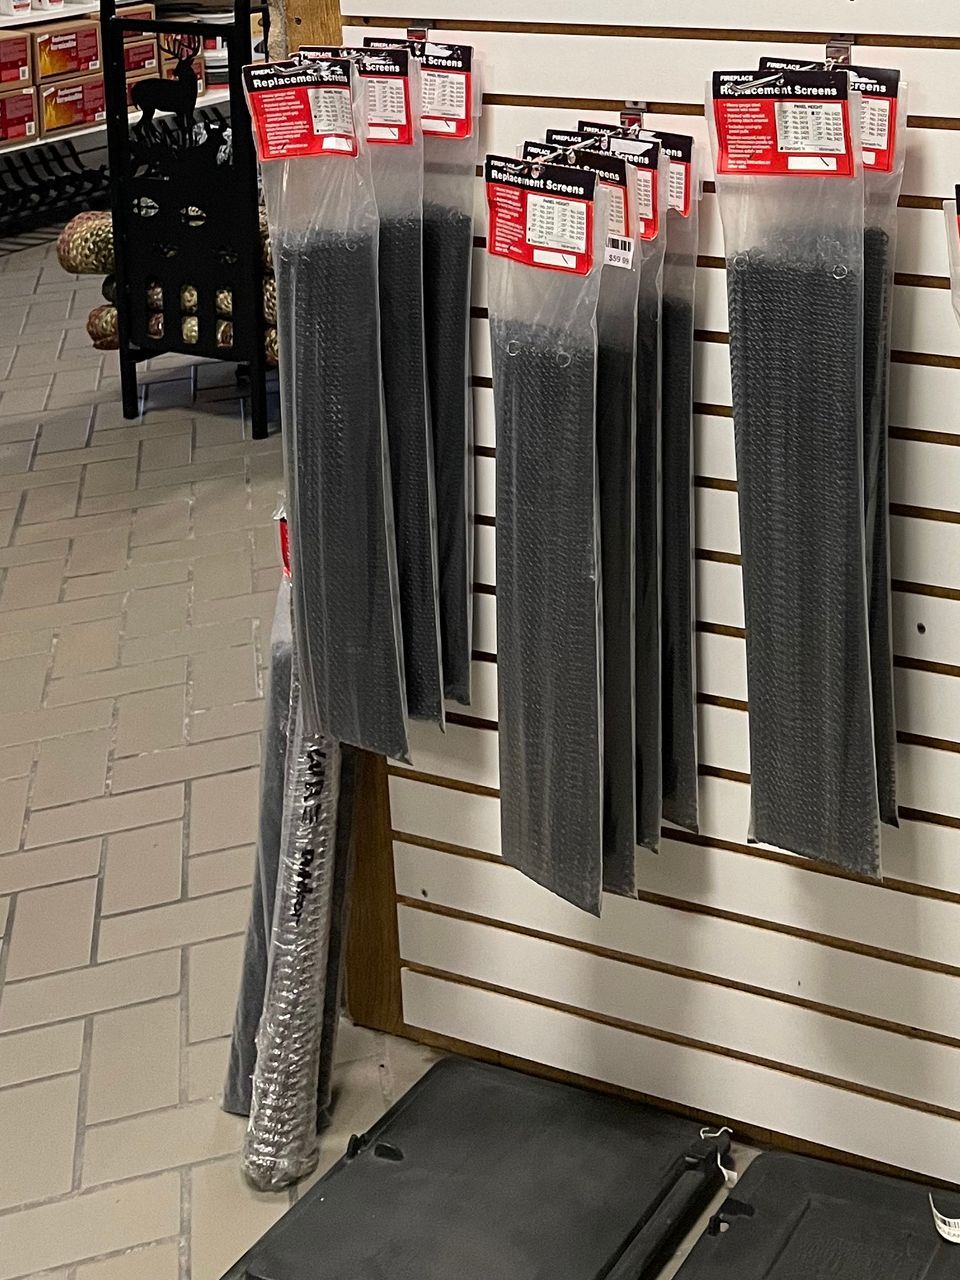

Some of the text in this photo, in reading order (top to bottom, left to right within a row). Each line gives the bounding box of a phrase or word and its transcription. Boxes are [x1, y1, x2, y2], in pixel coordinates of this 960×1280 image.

[365, 63, 400, 73] Screens
[428, 57, 463, 68] Screens
[767, 62, 800, 70] FIREPLACE
[253, 74, 320, 88] Replacement
[720, 85, 838, 97] Racement Screens
[850, 82, 887, 93] creens
[661, 148, 683, 157] eens
[491, 169, 584, 195] Replacement Screens
